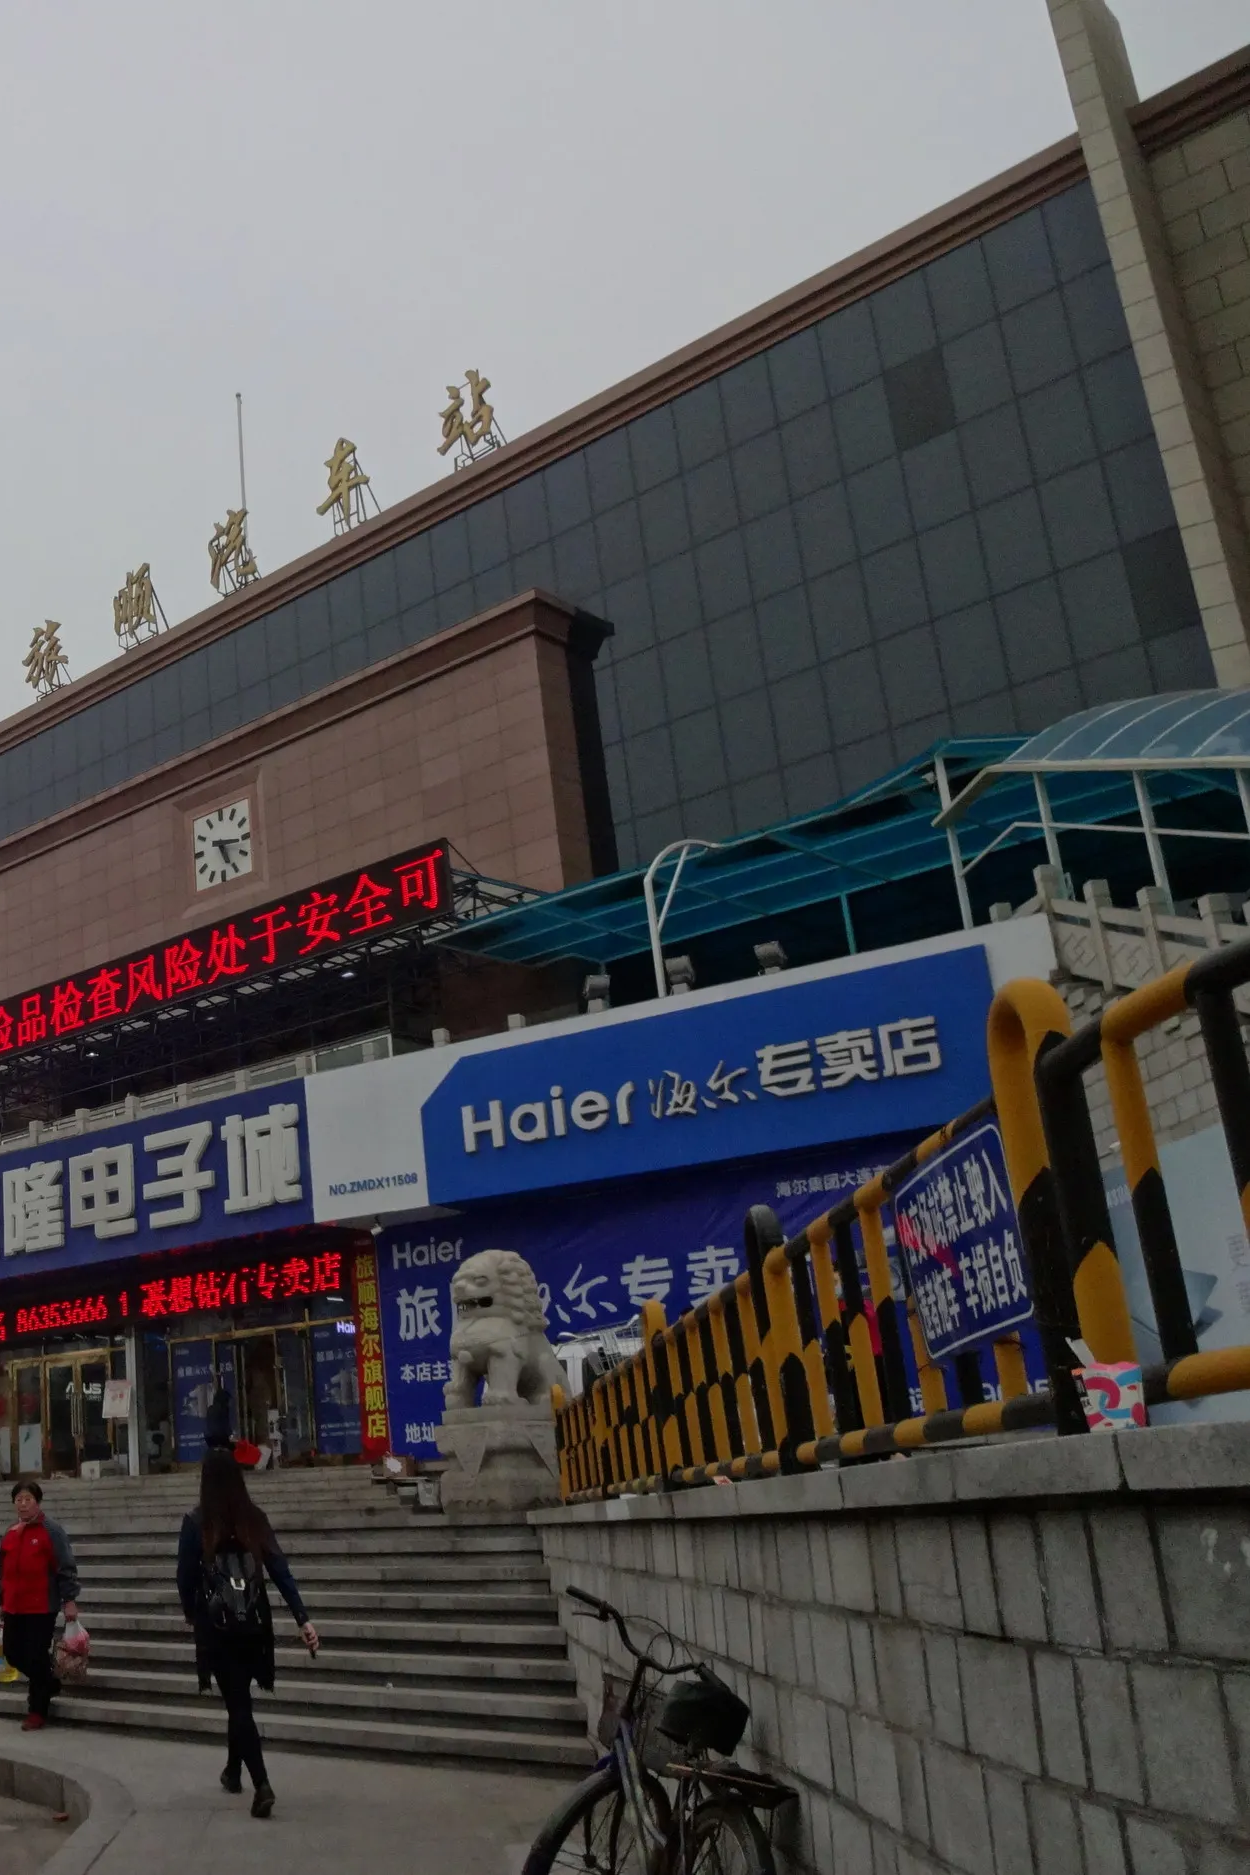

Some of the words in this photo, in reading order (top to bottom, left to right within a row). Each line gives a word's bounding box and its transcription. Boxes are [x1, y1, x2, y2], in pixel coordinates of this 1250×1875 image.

[22, 369, 495, 689] 旅顺汽车站
[462, 1079, 636, 1153] Haier
[391, 1235, 464, 1270] Haier
[958, 1229, 1028, 1320] 车损自负
[354, 1254, 388, 1441] 旅顺海尔旗舰店
[399, 1360, 454, 1384] 本店主
